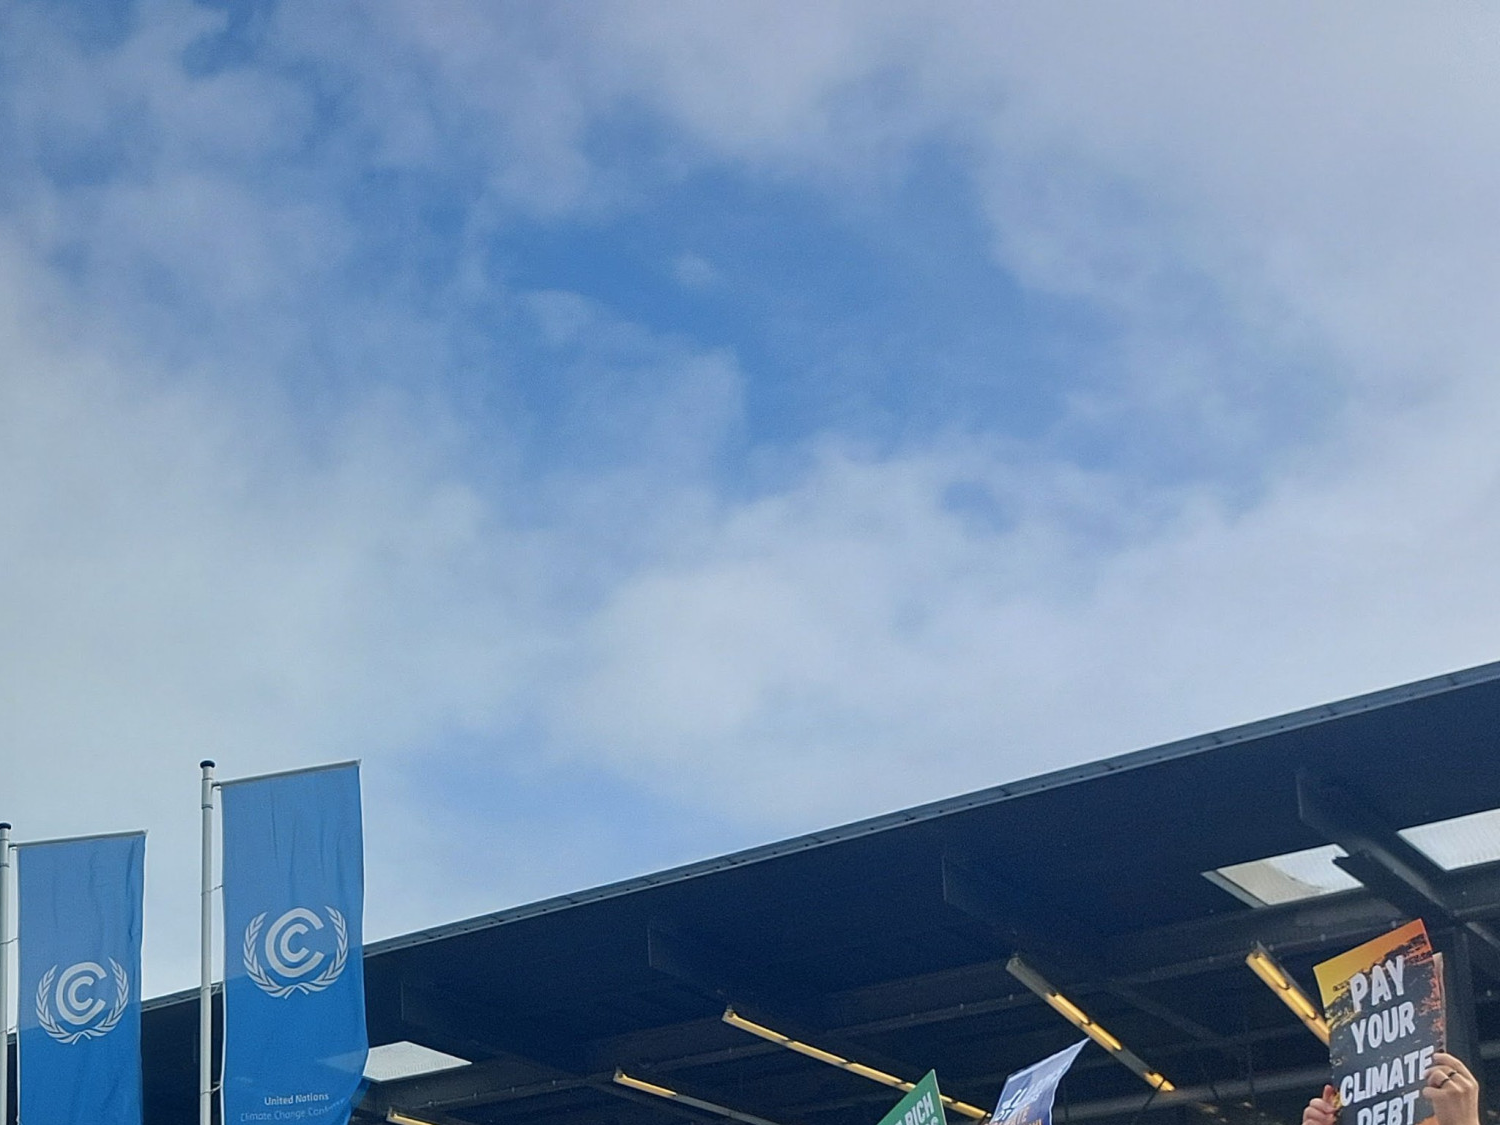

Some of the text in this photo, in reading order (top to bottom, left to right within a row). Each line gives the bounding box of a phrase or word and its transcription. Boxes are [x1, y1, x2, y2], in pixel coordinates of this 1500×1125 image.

[1348, 955, 1405, 1012] PAY
[1351, 1001, 1416, 1054] YOUR
[264, 1092, 330, 1106] United Nations
[1340, 1046, 1435, 1108] CLIMATE
